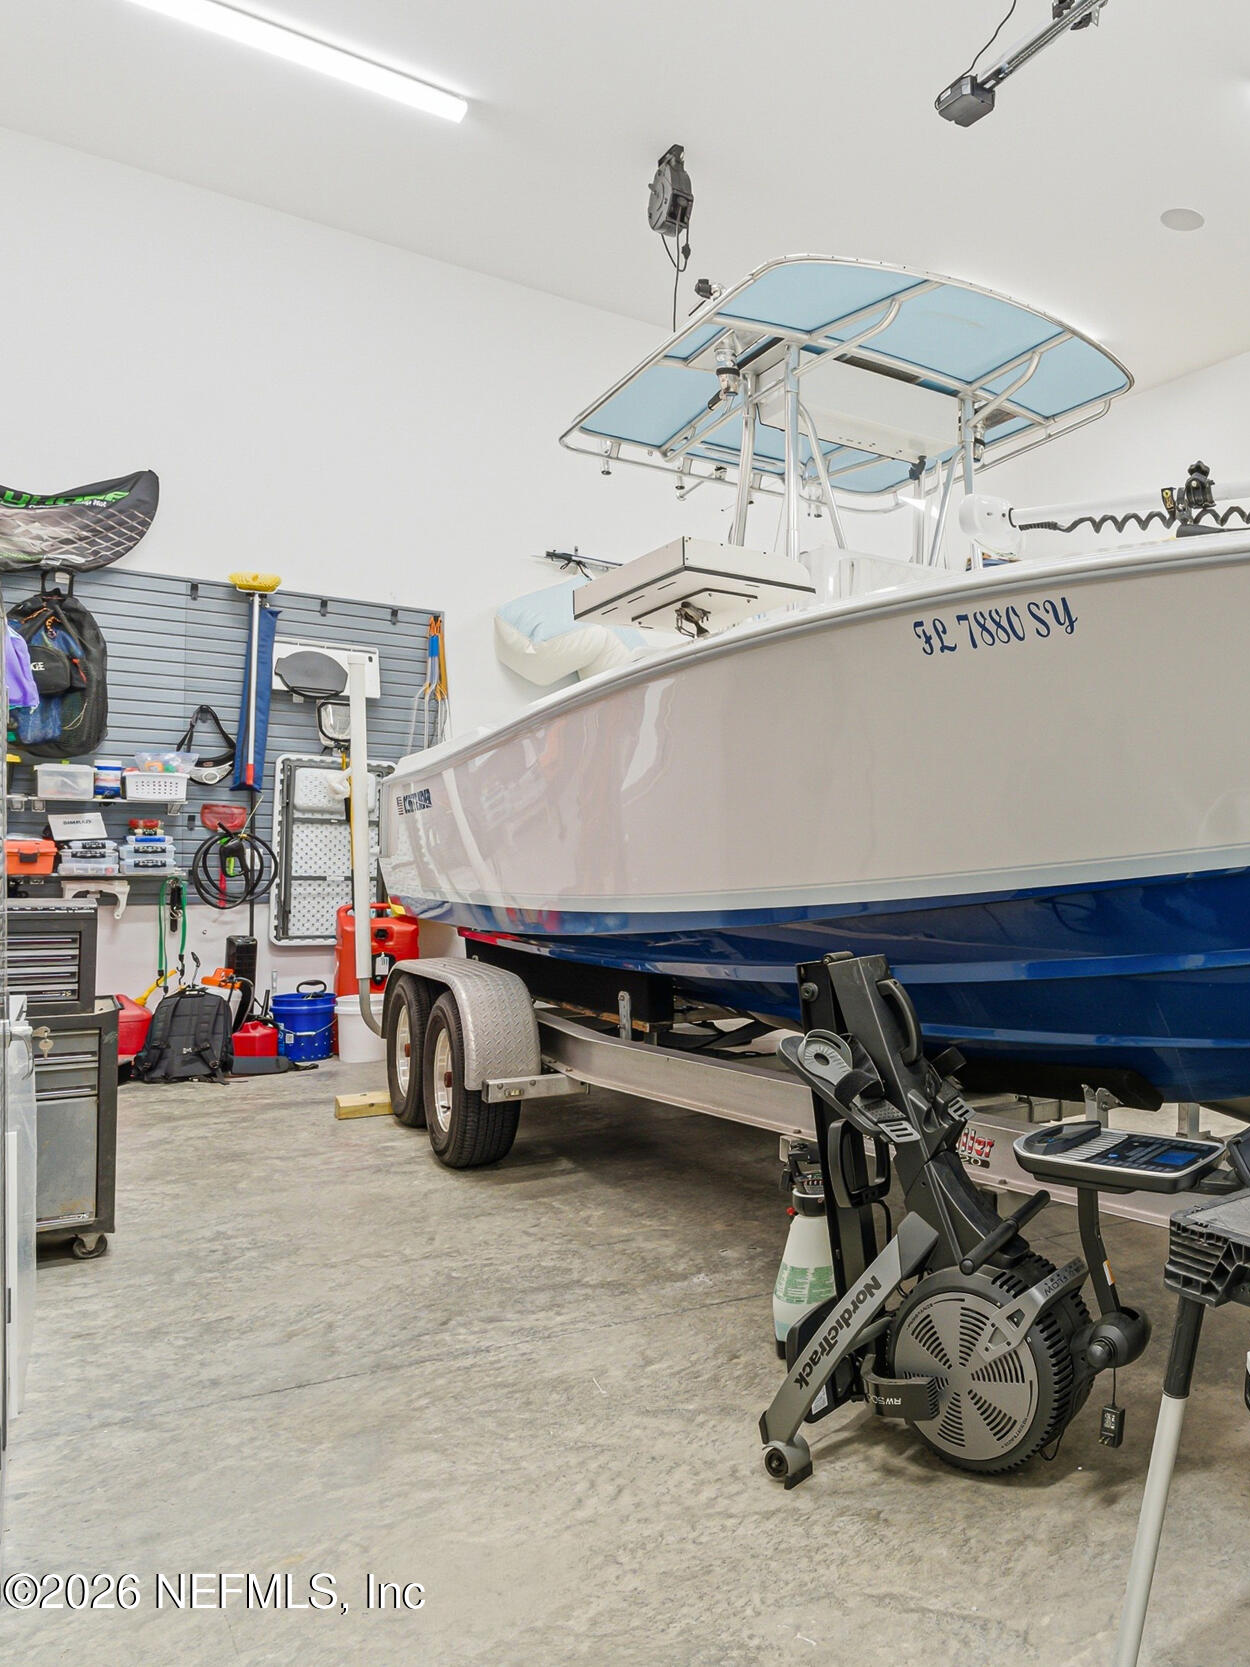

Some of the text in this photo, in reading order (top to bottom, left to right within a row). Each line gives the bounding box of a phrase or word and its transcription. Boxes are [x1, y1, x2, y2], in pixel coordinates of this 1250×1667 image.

[913, 597, 1078, 655] FL 7880 SY
[794, 1275, 882, 1390] NordicTrack
